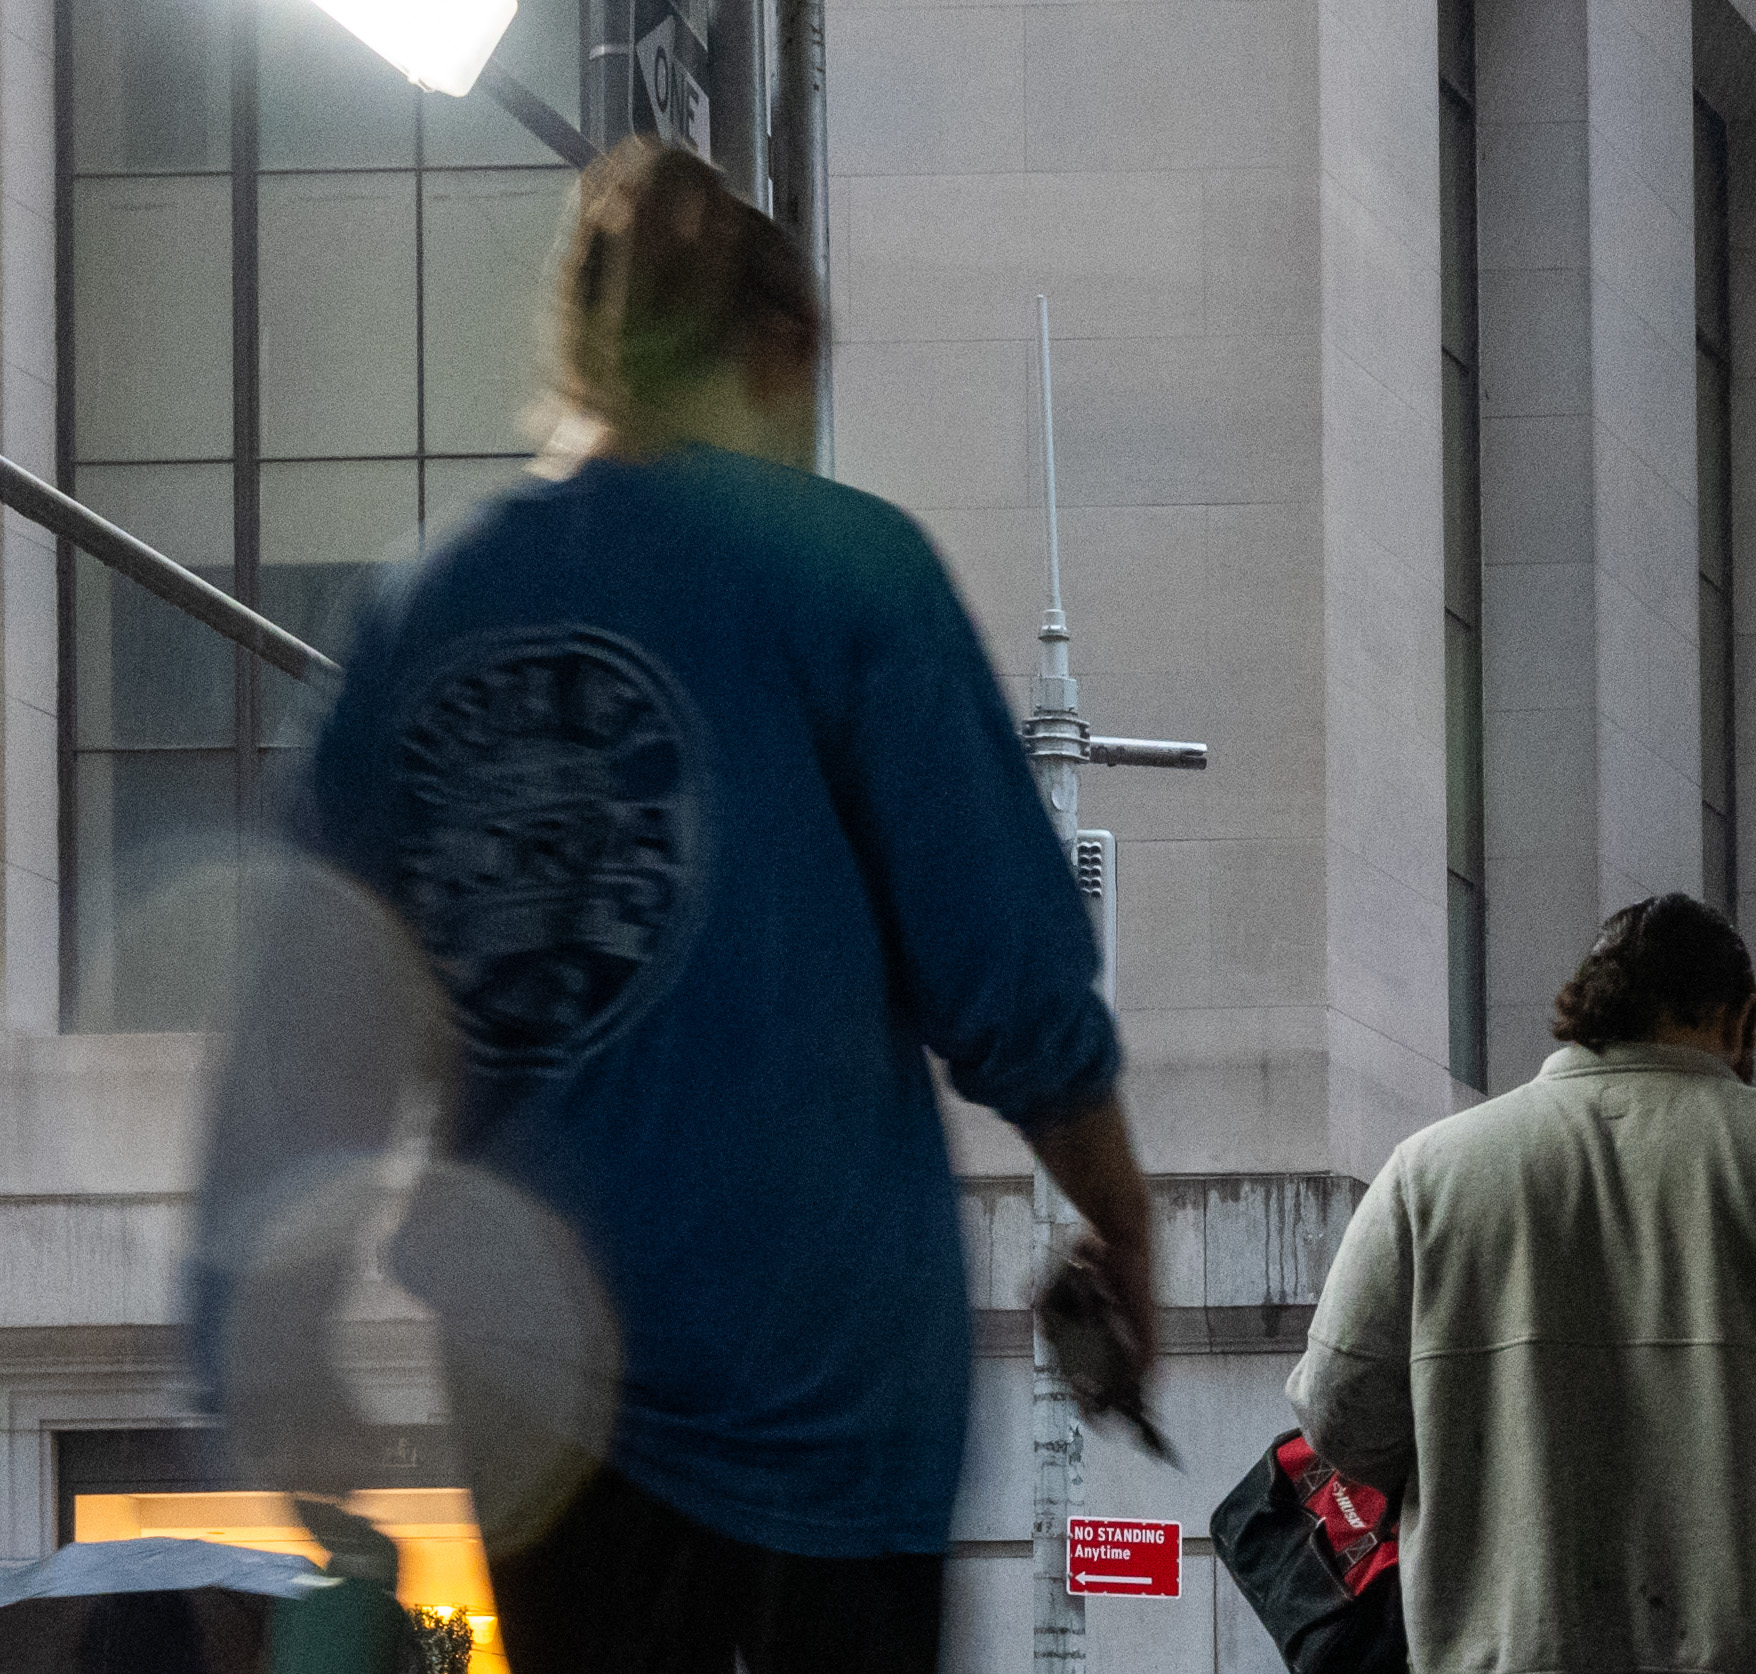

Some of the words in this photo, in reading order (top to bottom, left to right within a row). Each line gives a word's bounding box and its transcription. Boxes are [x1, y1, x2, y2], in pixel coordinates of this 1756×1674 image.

[1074, 1526, 1093, 1540] NO
[1098, 1527, 1165, 1544] STANDING
[1074, 1544, 1131, 1562] Anytime
